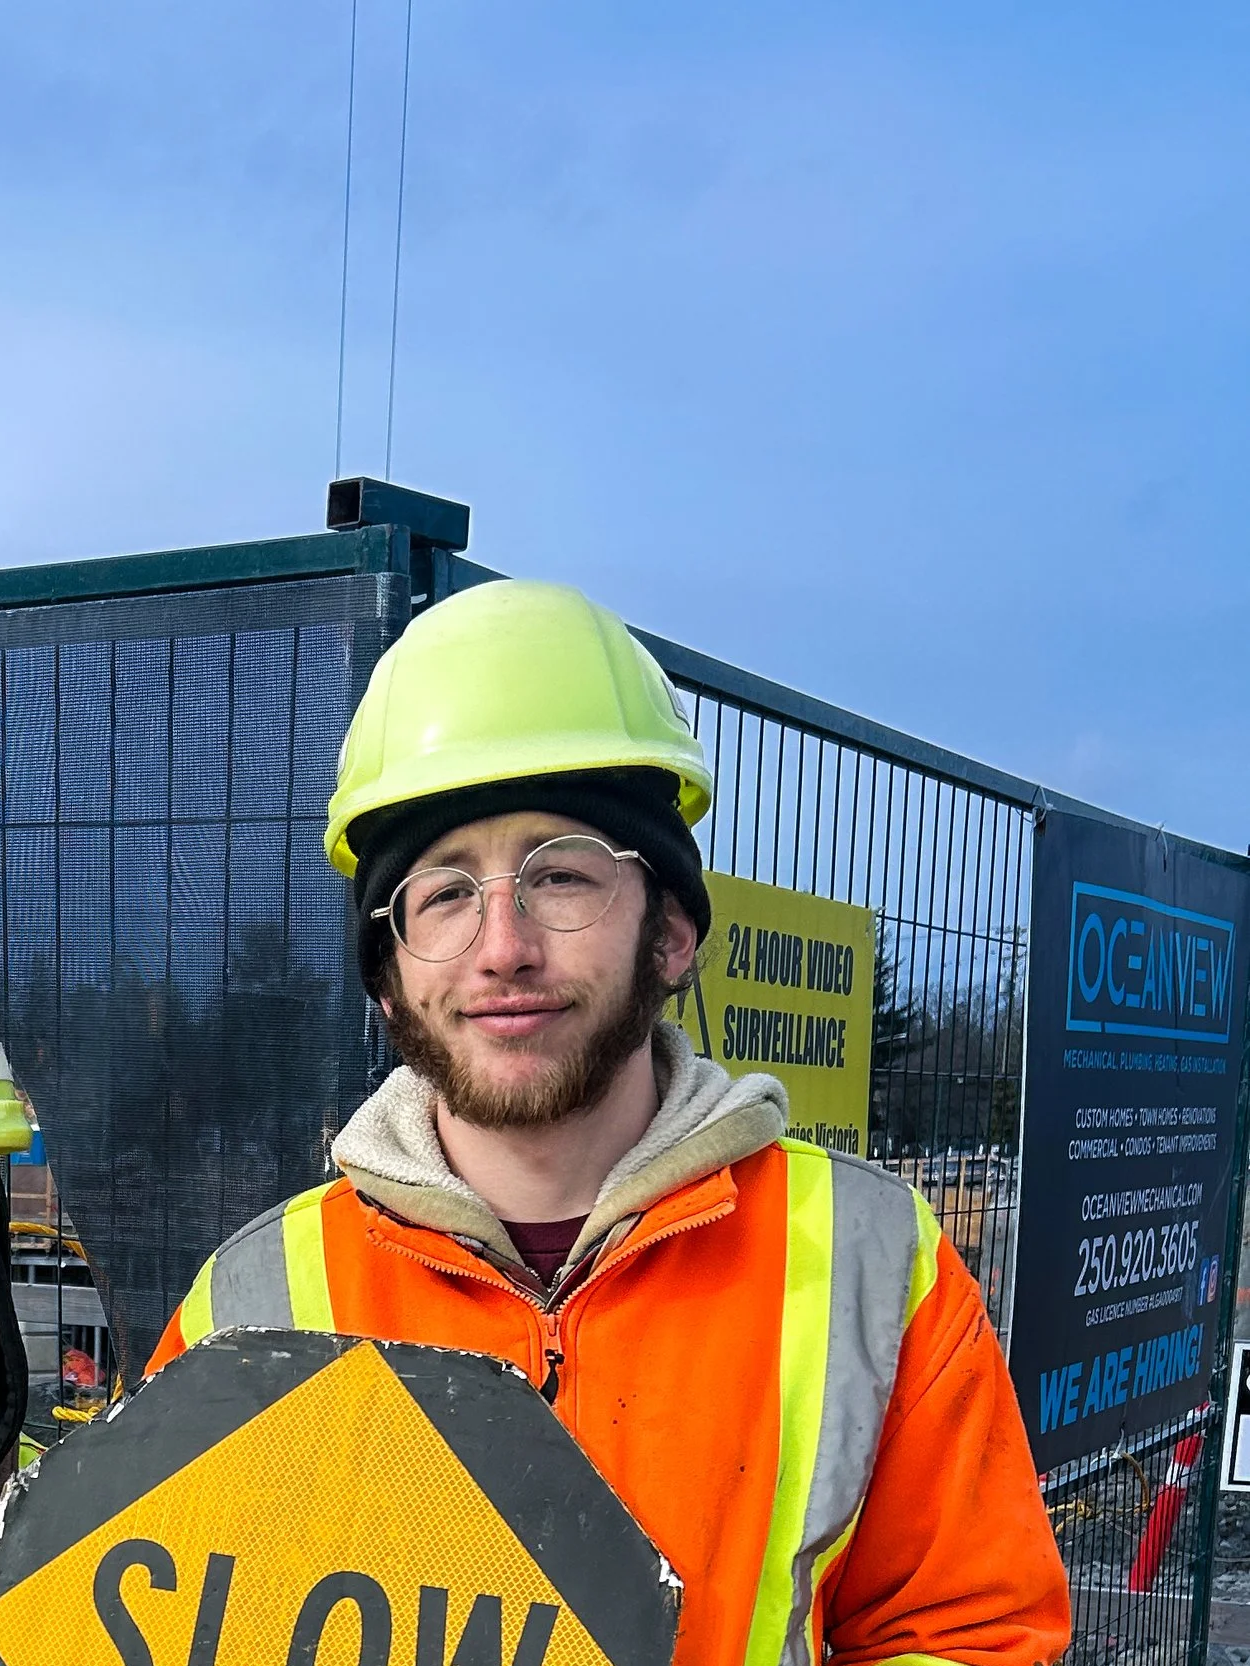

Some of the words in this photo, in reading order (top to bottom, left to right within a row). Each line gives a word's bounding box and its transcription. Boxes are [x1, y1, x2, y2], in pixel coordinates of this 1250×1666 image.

[726, 922, 751, 980] 24
[754, 928, 803, 988] HOUR
[807, 938, 854, 996] VIDEO
[1078, 913, 1235, 1020] OCEANVIEW
[723, 1004, 846, 1068] SURVEILLANCE
[1063, 1049, 1118, 1070] MECHANICAL,
[1075, 1108, 1108, 1128] CUSTOM
[1108, 1107, 1133, 1128] HOMES
[1139, 1107, 1157, 1127] TOWN
[1158, 1107, 1178, 1126] HOMES
[1181, 1107, 1216, 1125] RENOVATIONS
[815, 1122, 859, 1154] Victoria
[1068, 1138, 1118, 1160] COMMERCIAL
[1124, 1136, 1151, 1156] CONDOS
[1156, 1135, 1179, 1154] TENANT
[1179, 1133, 1217, 1152] IMPROVEMENTS
[1082, 1182, 1203, 1221] OCEANVIEWMECHANICAL.COM
[1074, 1220, 1199, 1297] 250.920.3605
[1085, 1307, 1099, 1327] GAS
[1099, 1301, 1125, 1323] LICENCE
[1125, 1296, 1149, 1316] NUMBER
[1039, 1362, 1083, 1435] WE
[1082, 1346, 1133, 1418] ARE
[1132, 1323, 1205, 1399] HIRING!
